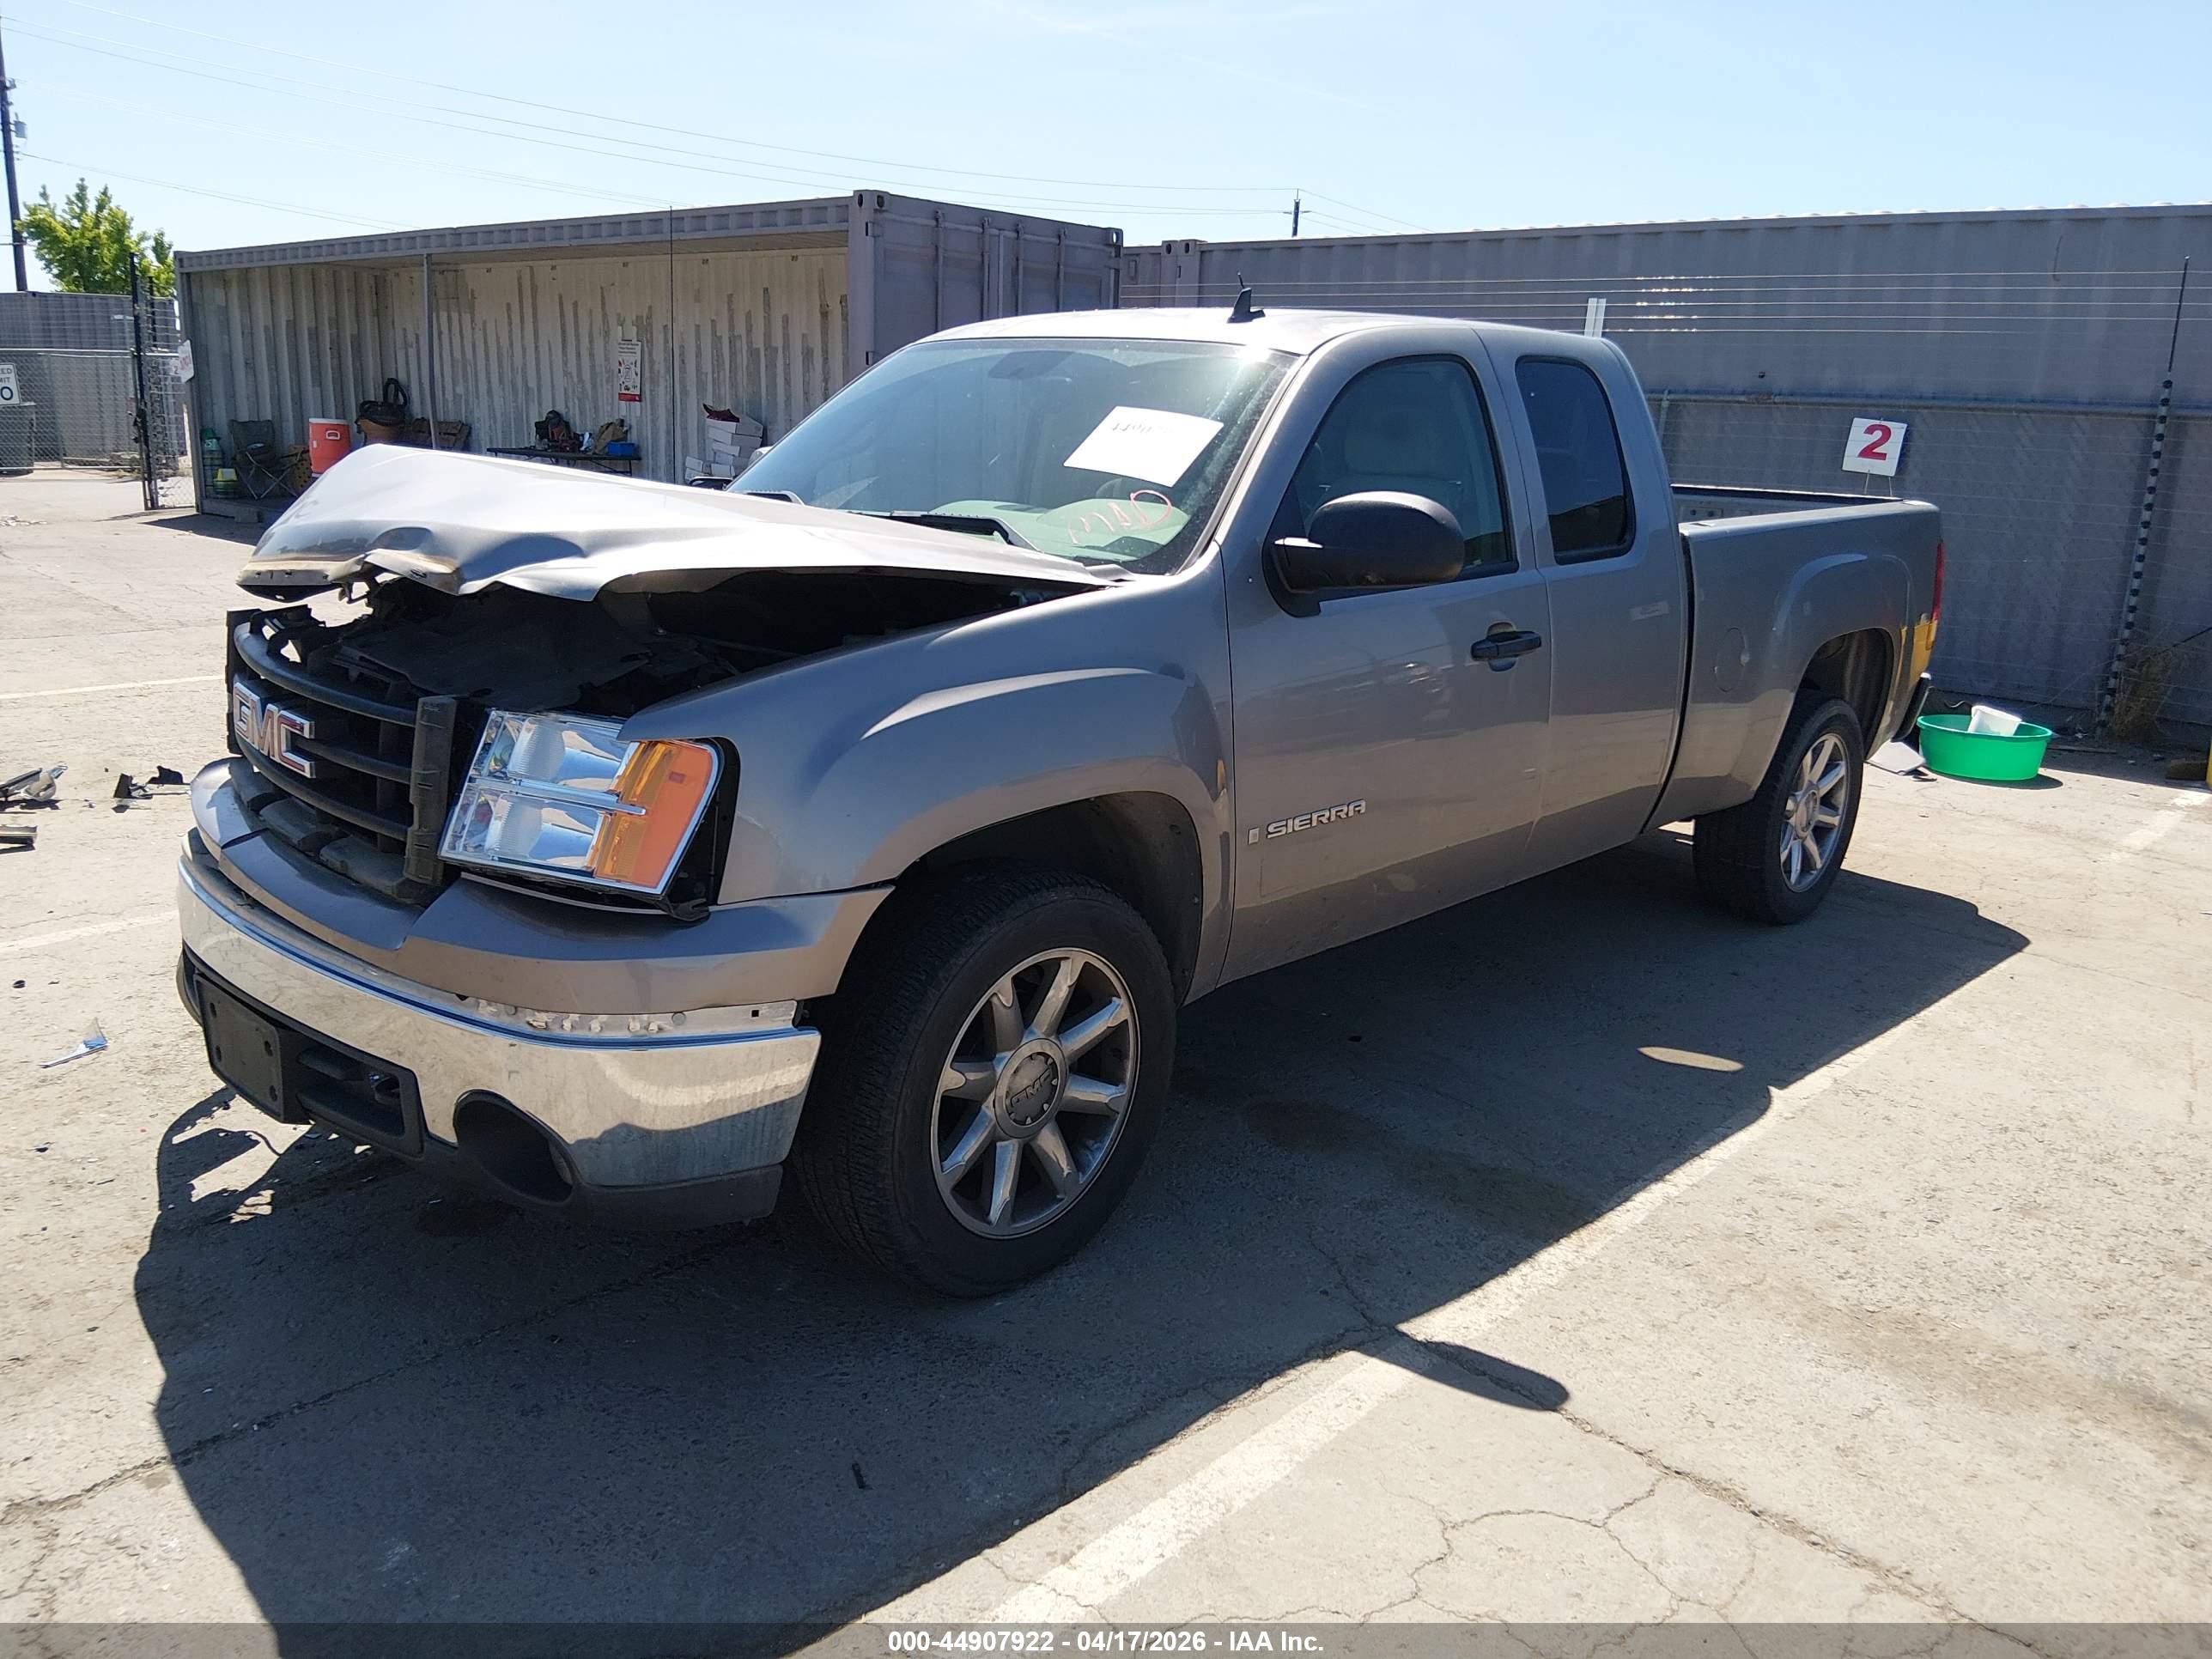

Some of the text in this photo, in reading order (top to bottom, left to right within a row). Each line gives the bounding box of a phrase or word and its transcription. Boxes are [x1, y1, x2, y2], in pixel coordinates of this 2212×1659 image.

[1857, 423, 1892, 460] 2
[233, 682, 316, 779] GMC
[1267, 799, 1367, 839] SIERRA
